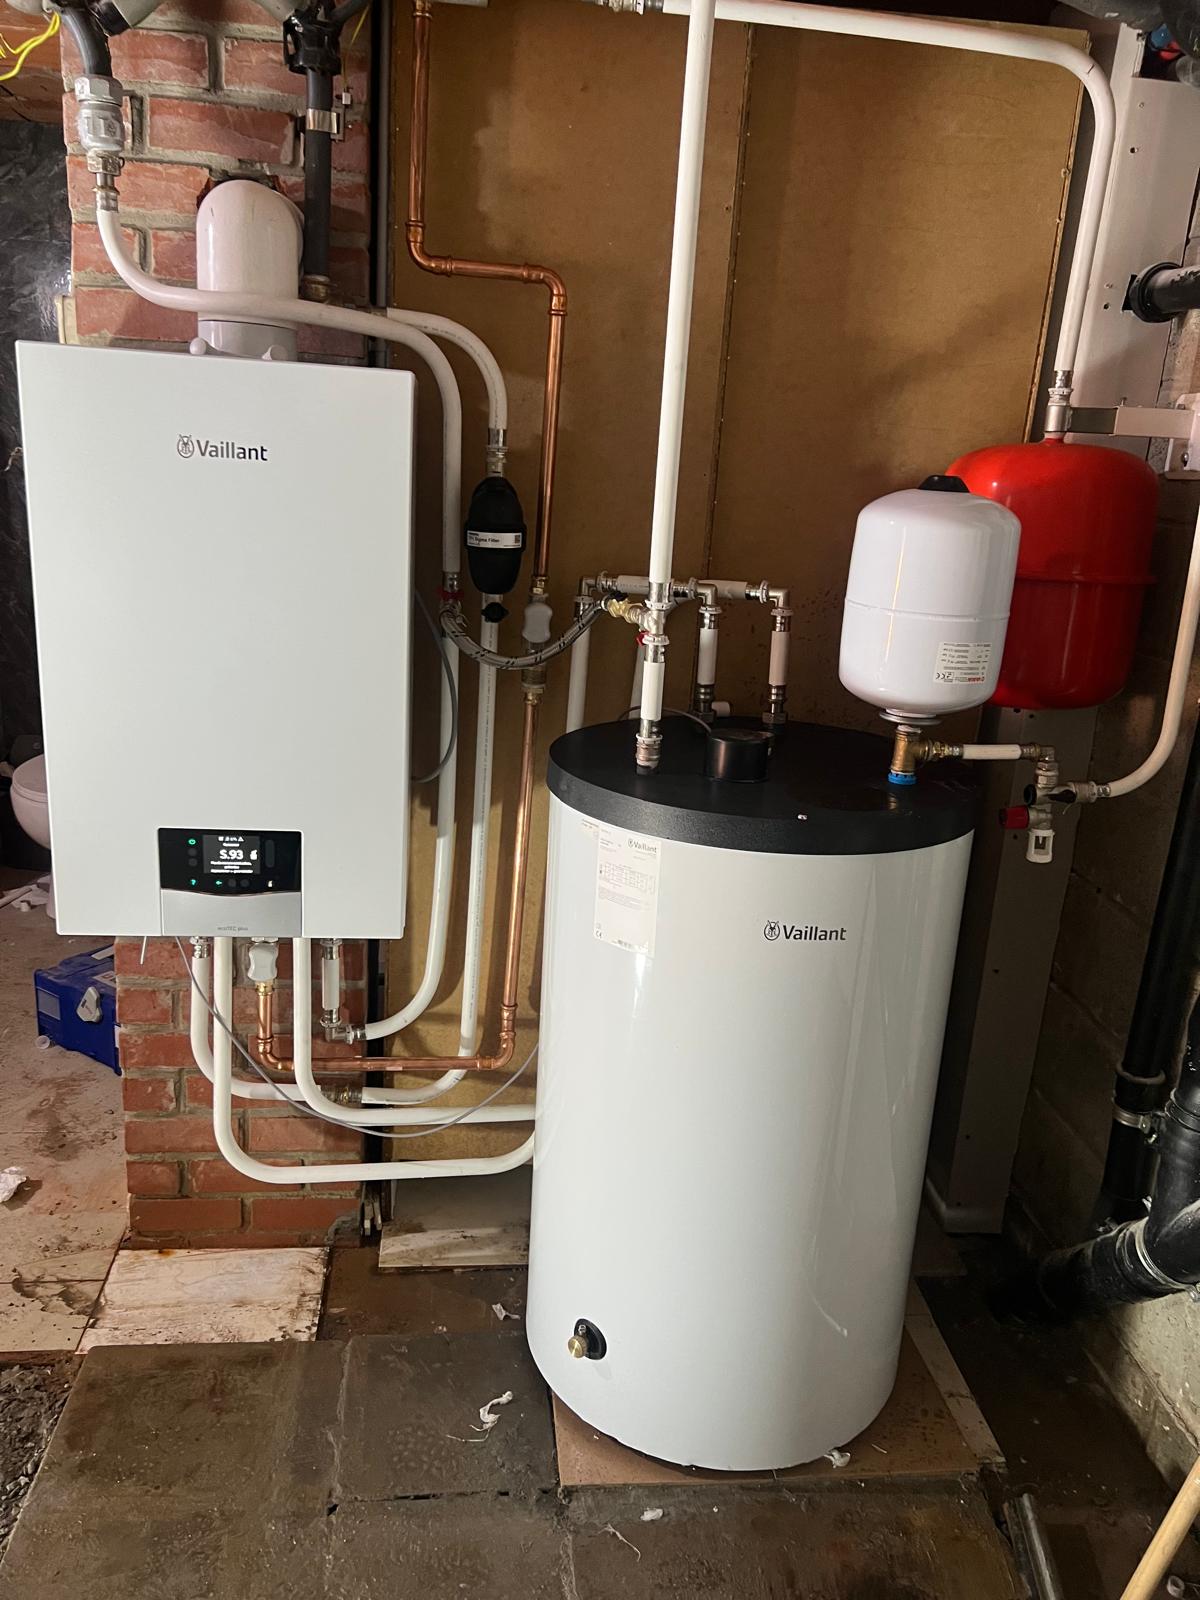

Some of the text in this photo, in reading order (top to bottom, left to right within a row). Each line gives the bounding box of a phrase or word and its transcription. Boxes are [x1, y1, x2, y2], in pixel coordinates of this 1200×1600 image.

[196, 439, 268, 461] Vaillant
[633, 840, 657, 853] Vaillant
[220, 849, 244, 860] S.93
[783, 924, 847, 941] Vaillant
